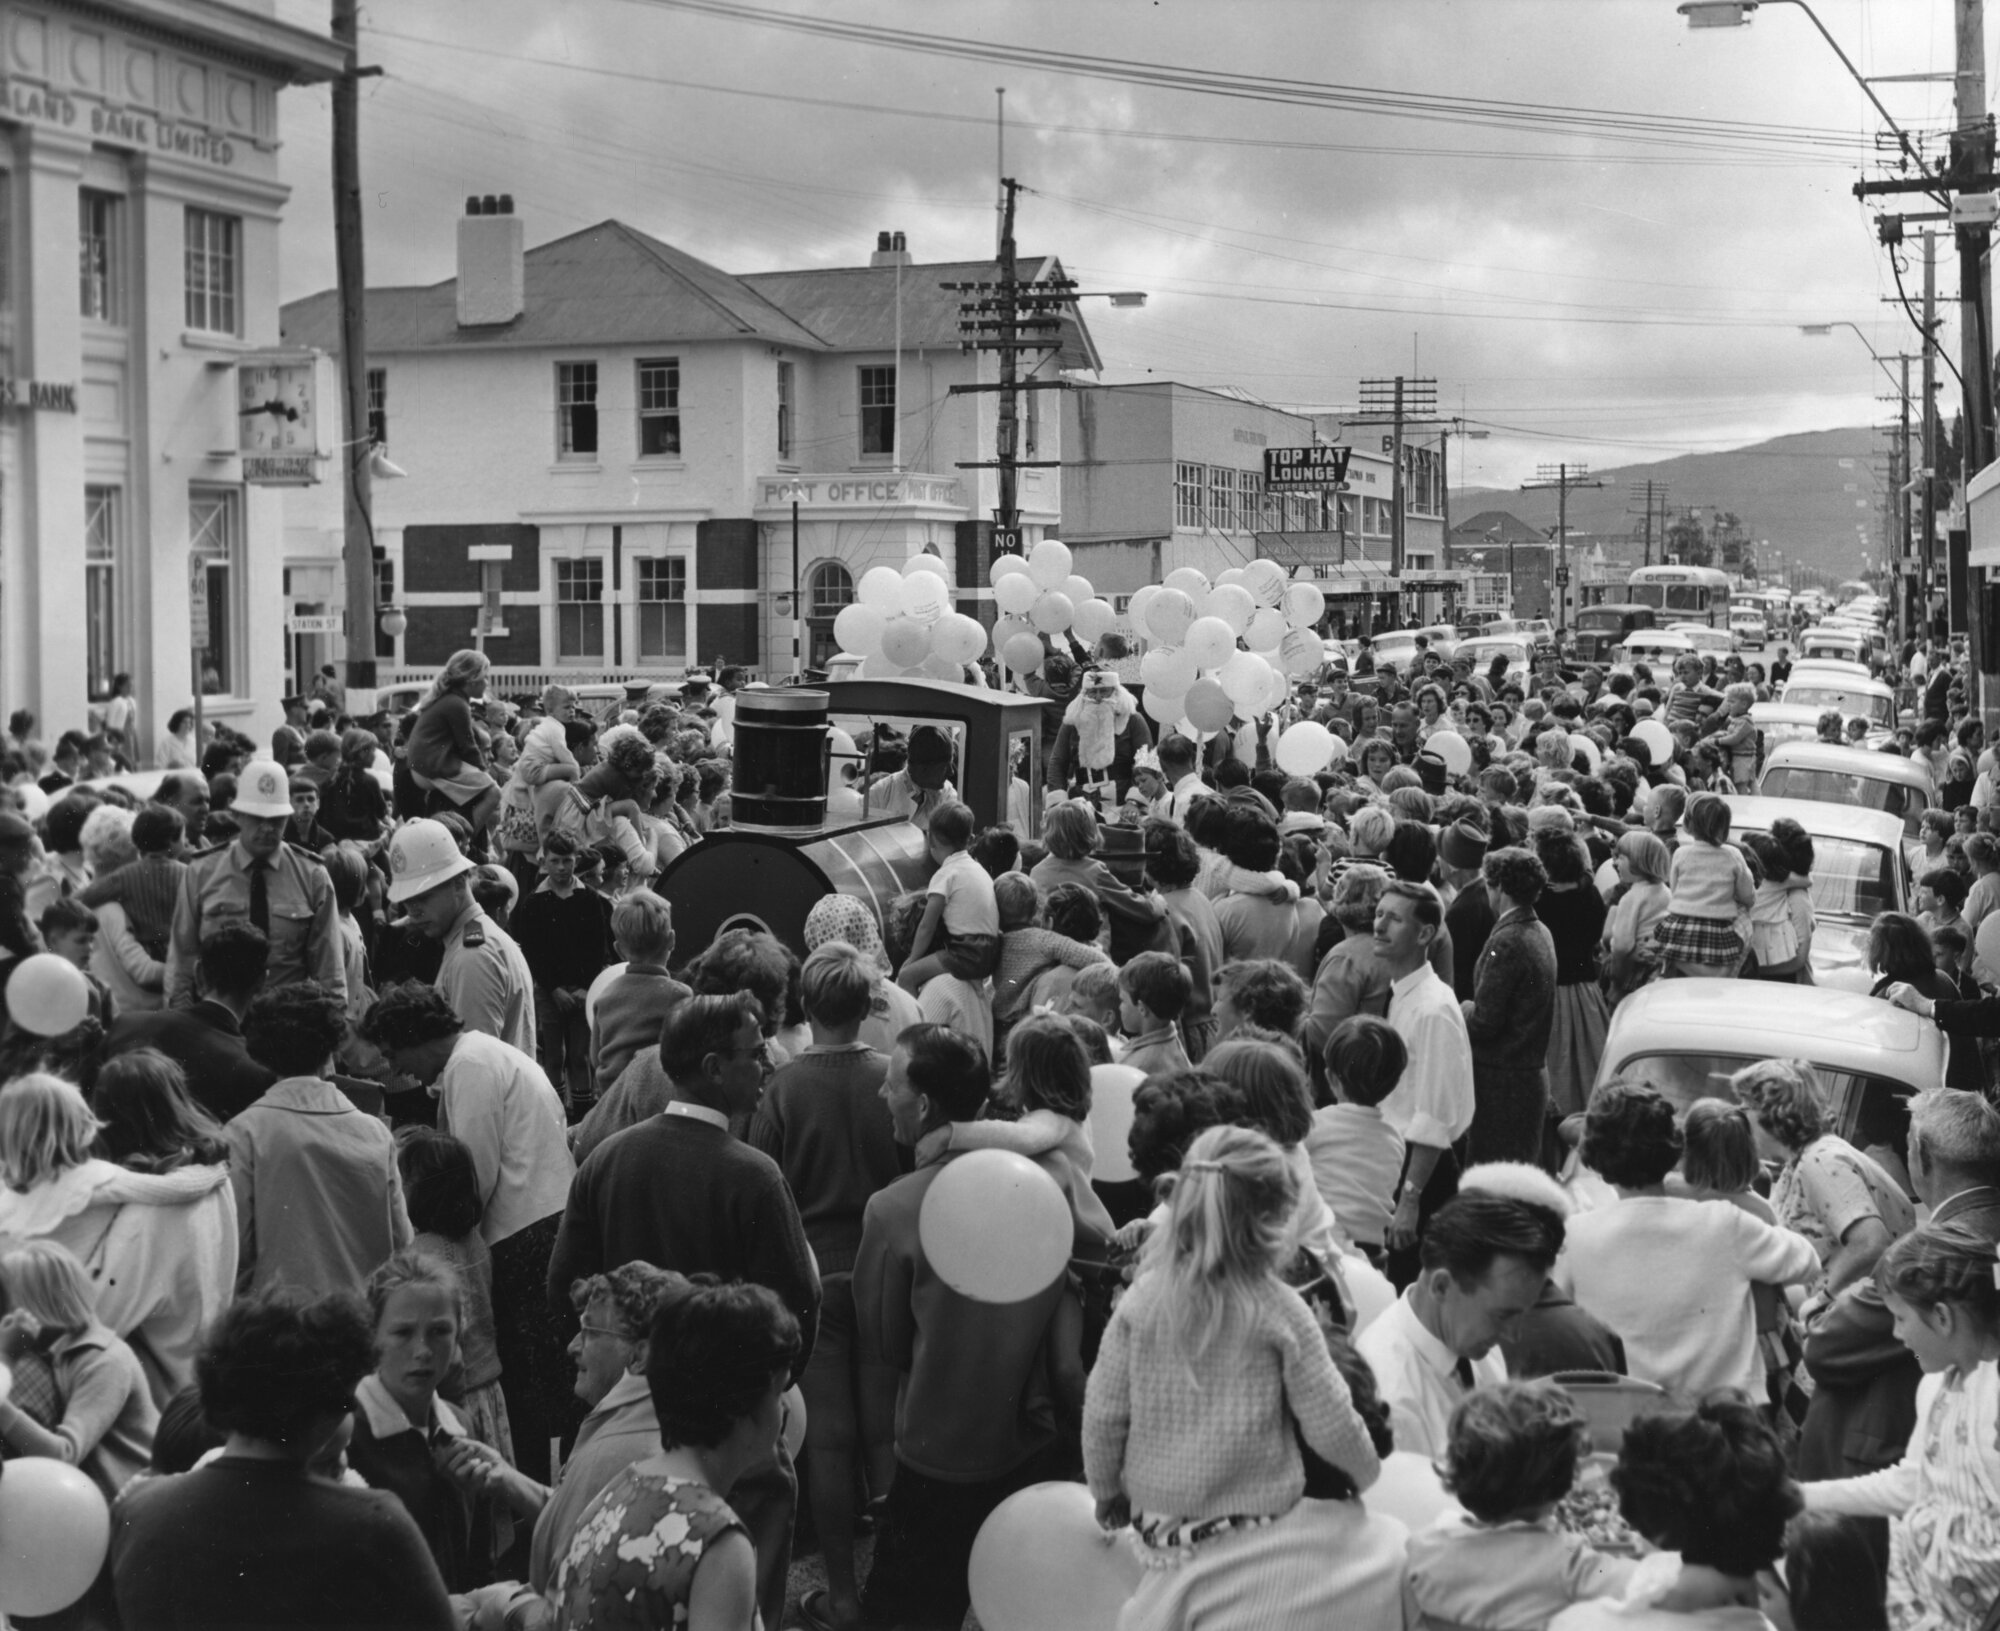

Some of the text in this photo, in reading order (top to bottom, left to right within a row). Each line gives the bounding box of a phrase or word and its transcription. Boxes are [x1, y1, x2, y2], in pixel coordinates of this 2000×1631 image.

[91, 106, 148, 144] BANK
[156, 123, 235, 166] LIMITED
[29, 381, 77, 415] BANK
[1269, 448, 1346, 465] TOP HAT
[1270, 465, 1336, 482] LOUNGE
[765, 482, 899, 503] POT OFFICE
[1322, 481, 1345, 491] TEA
[995, 533, 1016, 548] NO
[194, 555, 202, 577] P
[191, 577, 205, 595] 60
[292, 618, 337, 631] STATION ST
